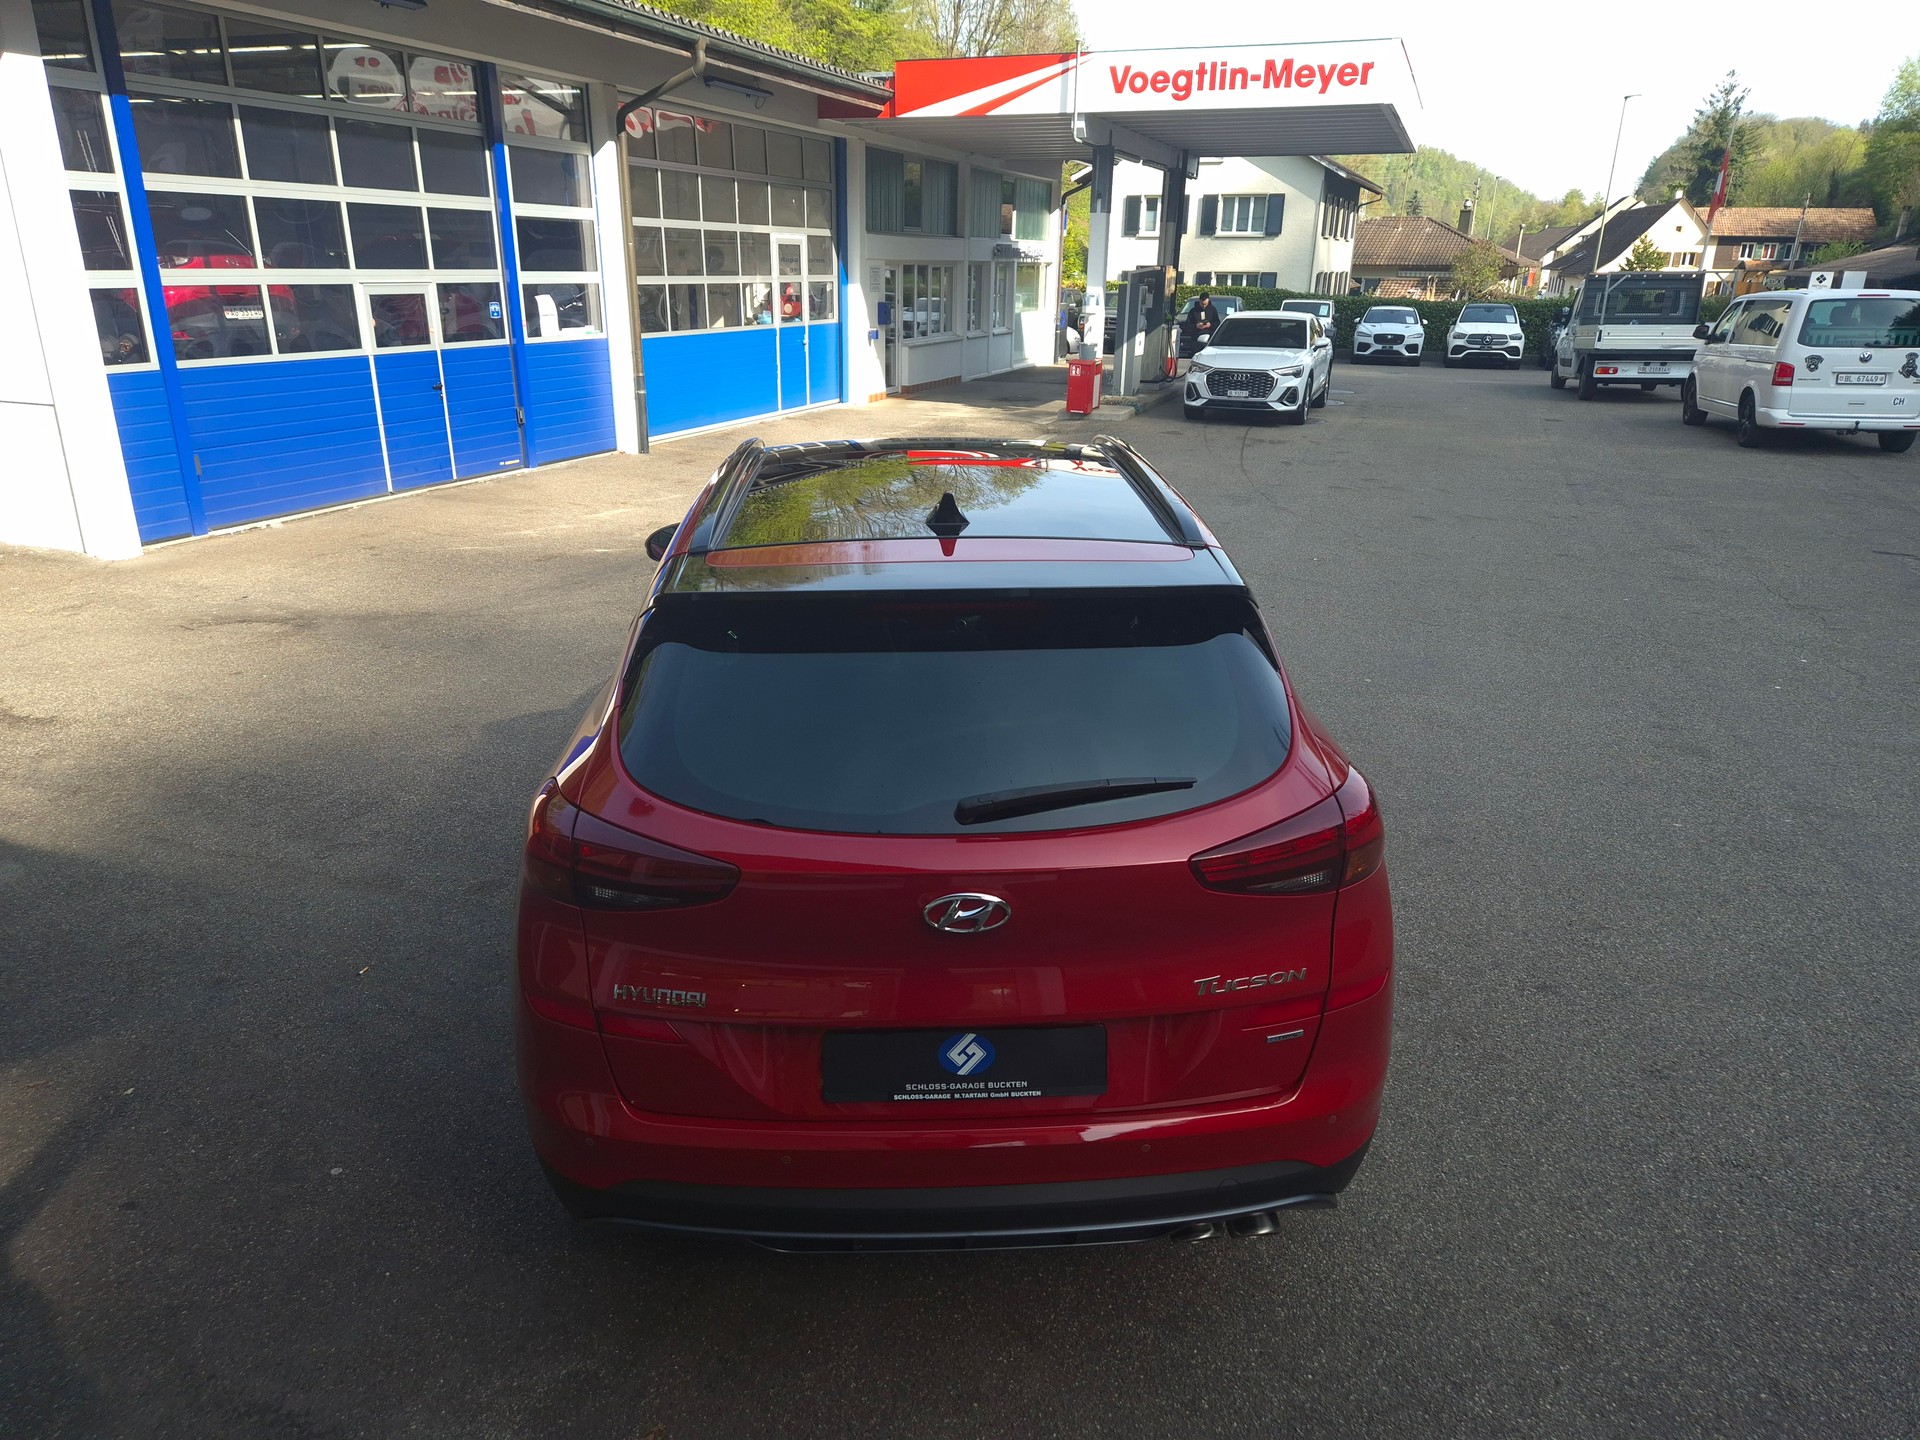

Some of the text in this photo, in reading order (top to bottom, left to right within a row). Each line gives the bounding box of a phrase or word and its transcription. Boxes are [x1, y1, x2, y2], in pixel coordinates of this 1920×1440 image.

[1109, 58, 1375, 101] Voegtlin-Meyer
[1844, 375, 1879, 383] BL 67449
[1893, 398, 1905, 406] CH
[613, 984, 707, 1008] HYUNDAI
[905, 1080, 1028, 1091] SCHLOSS-GARAGE BUCKTEN
[893, 1093, 951, 1101] SCHLOSS-GARAGE
[1010, 1090, 1042, 1098] BUCKTEN
